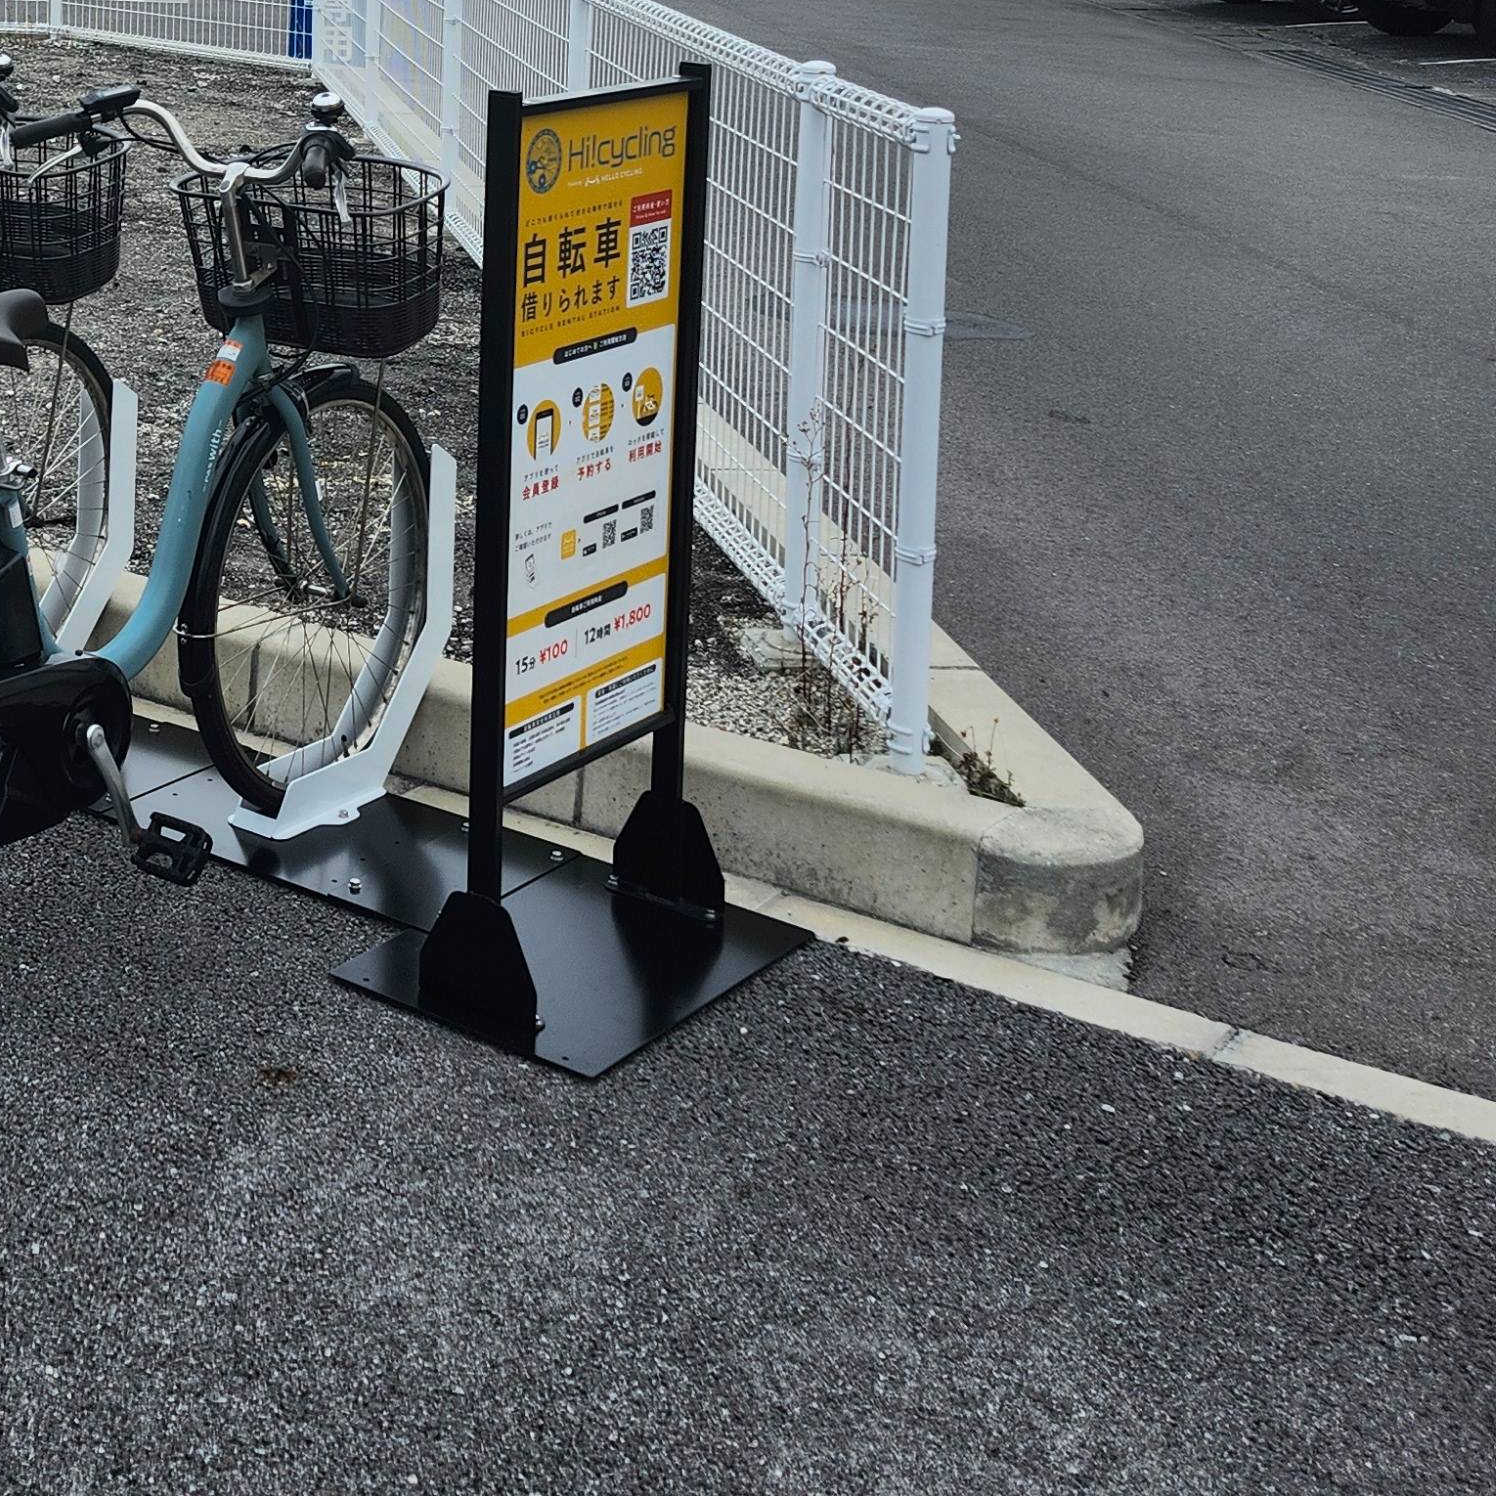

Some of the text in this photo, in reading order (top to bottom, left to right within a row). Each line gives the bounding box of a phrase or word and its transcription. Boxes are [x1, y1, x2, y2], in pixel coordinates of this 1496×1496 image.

[567, 125, 677, 172] Hi!cycling
[522, 216, 622, 289] 自転車
[520, 275, 621, 323] 借りられます
[520, 305, 621, 338] BICYCLE RENTAL STATION
[577, 457, 612, 481] 予約する
[628, 439, 663, 464] 利用開始
[521, 475, 560, 501] 会員登録
[583, 623, 611, 645] 12時間
[613, 603, 651, 632] ¥1,800
[515, 639, 569, 675] 15分 ¥100
